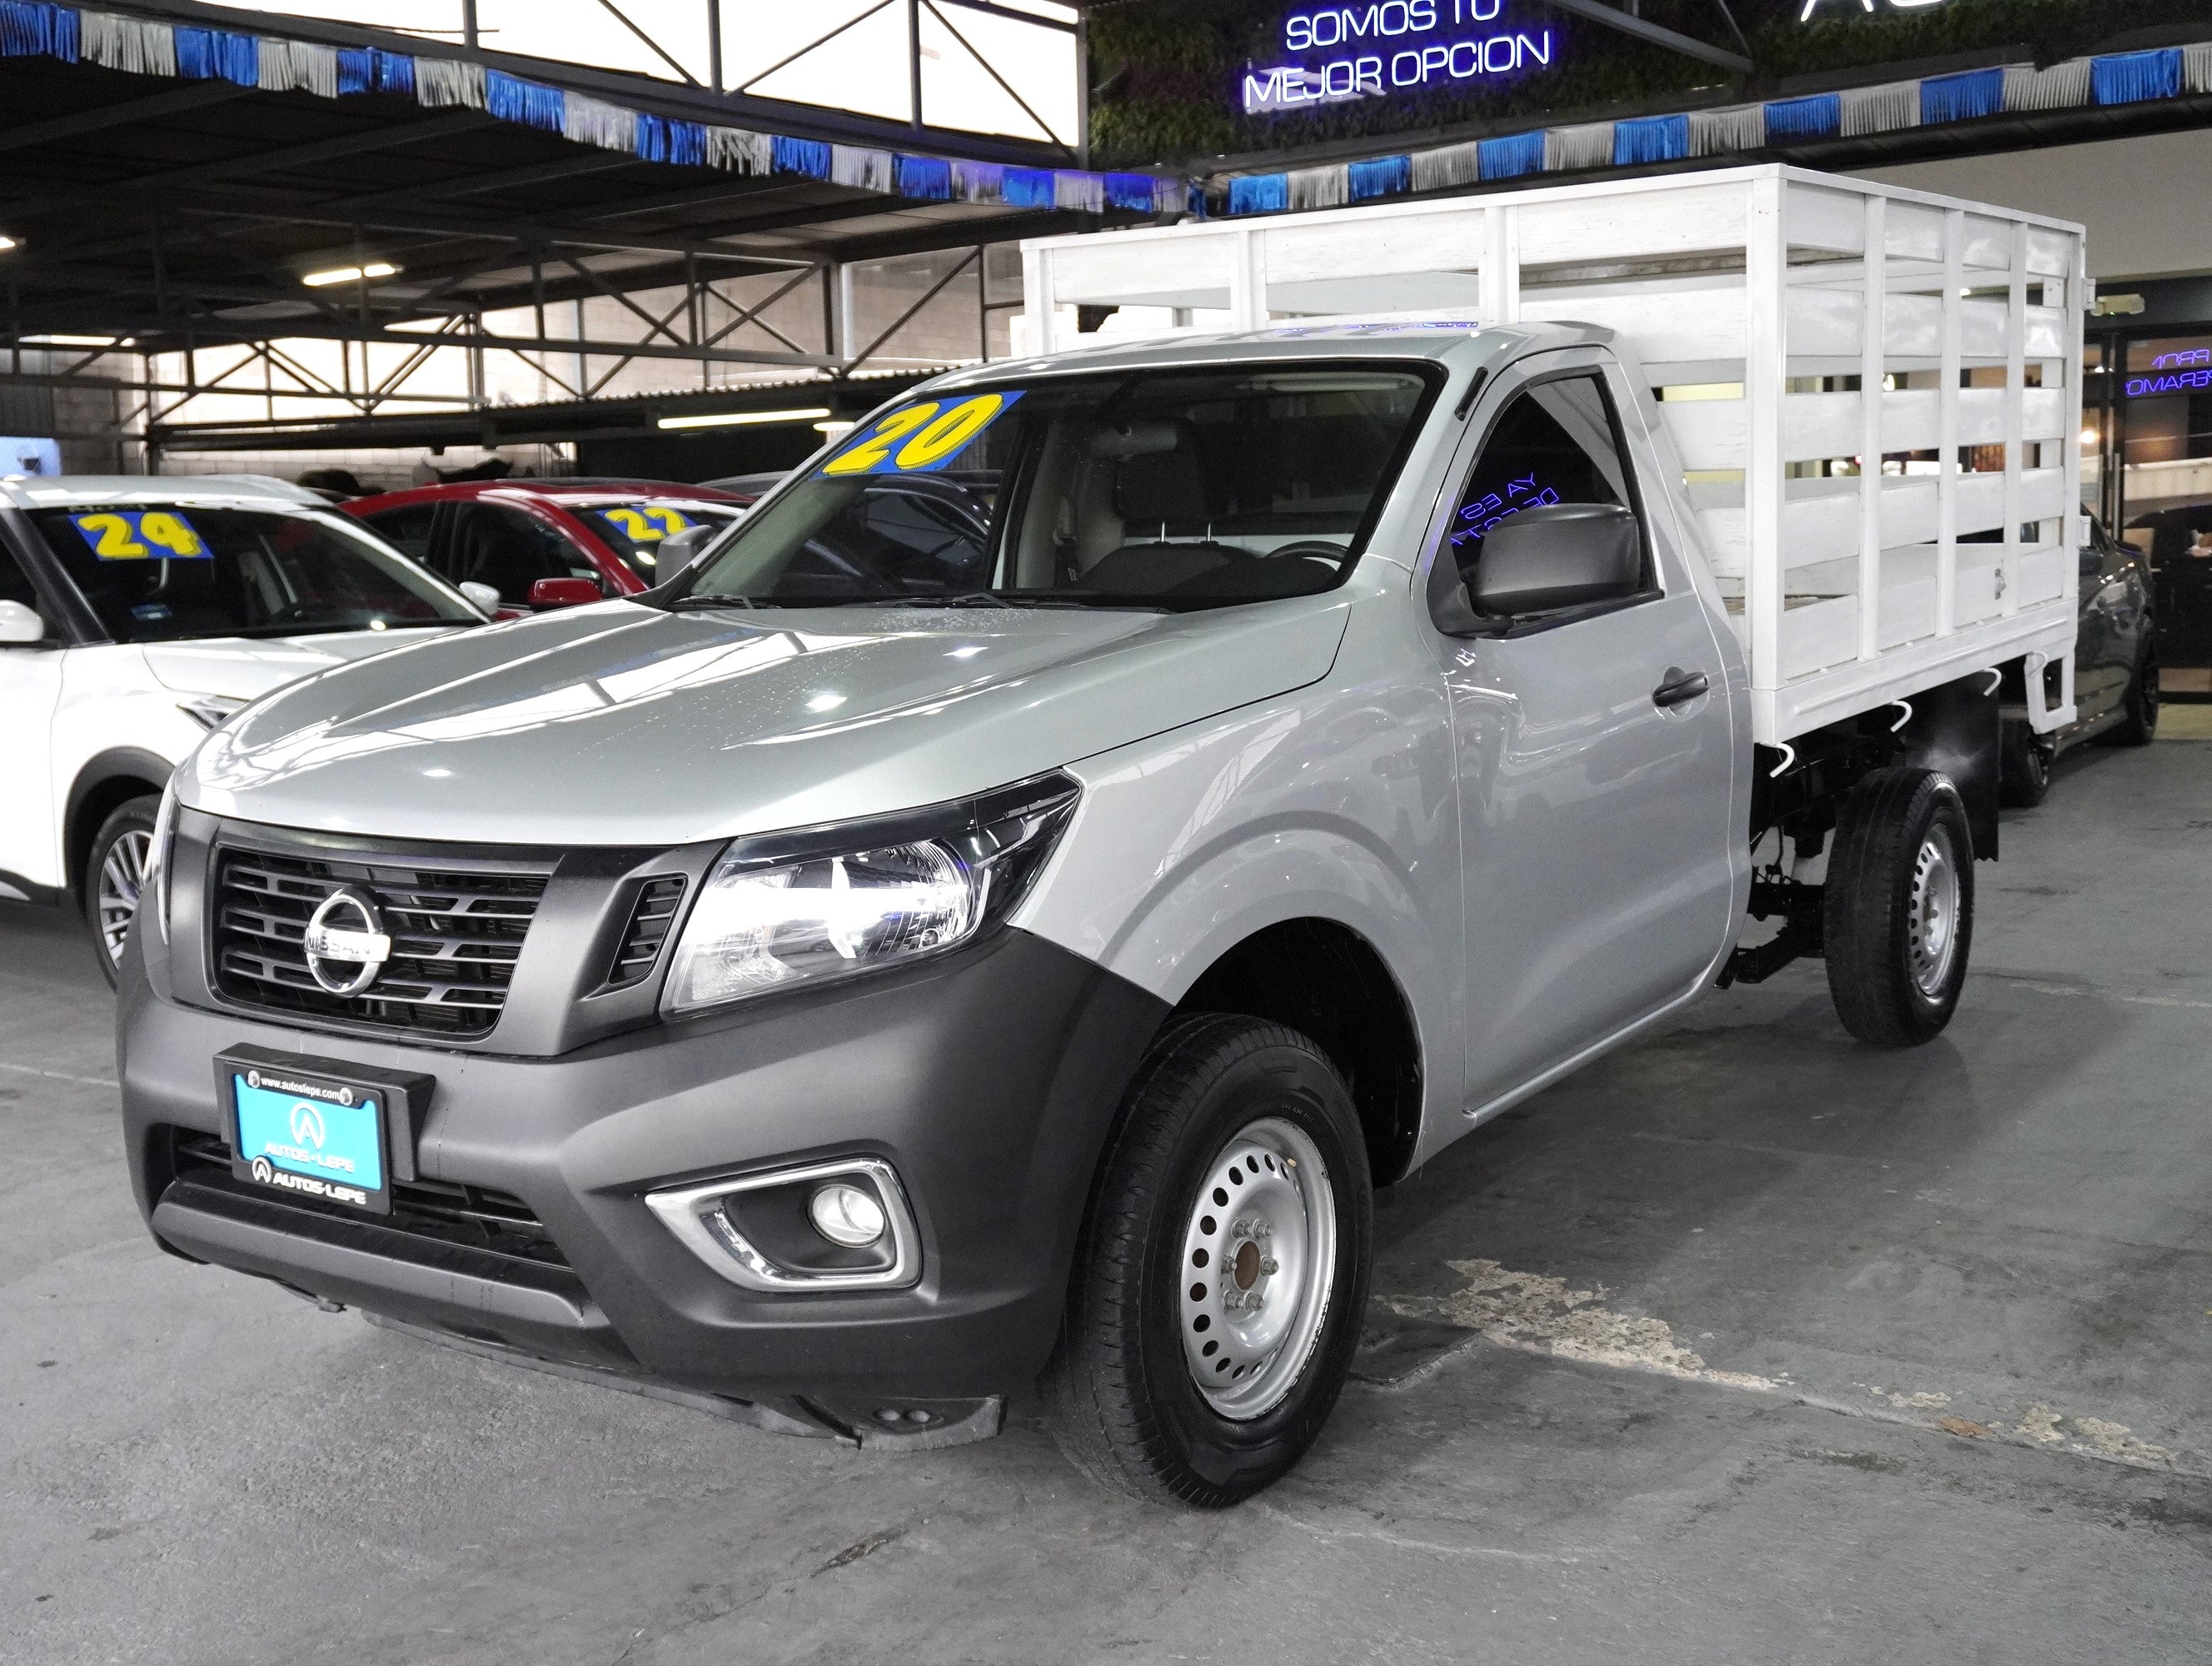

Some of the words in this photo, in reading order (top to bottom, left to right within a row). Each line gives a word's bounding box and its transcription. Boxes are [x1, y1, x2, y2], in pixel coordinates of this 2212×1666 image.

[1285, 0, 1437, 51] SOMOS
[1243, 56, 1382, 108] MEJOR
[1391, 31, 1550, 87] OPCION
[822, 393, 1004, 476] 20
[77, 512, 202, 557] 24
[605, 506, 686, 541] 22
[261, 1077, 341, 1100] www.autoslepe.com
